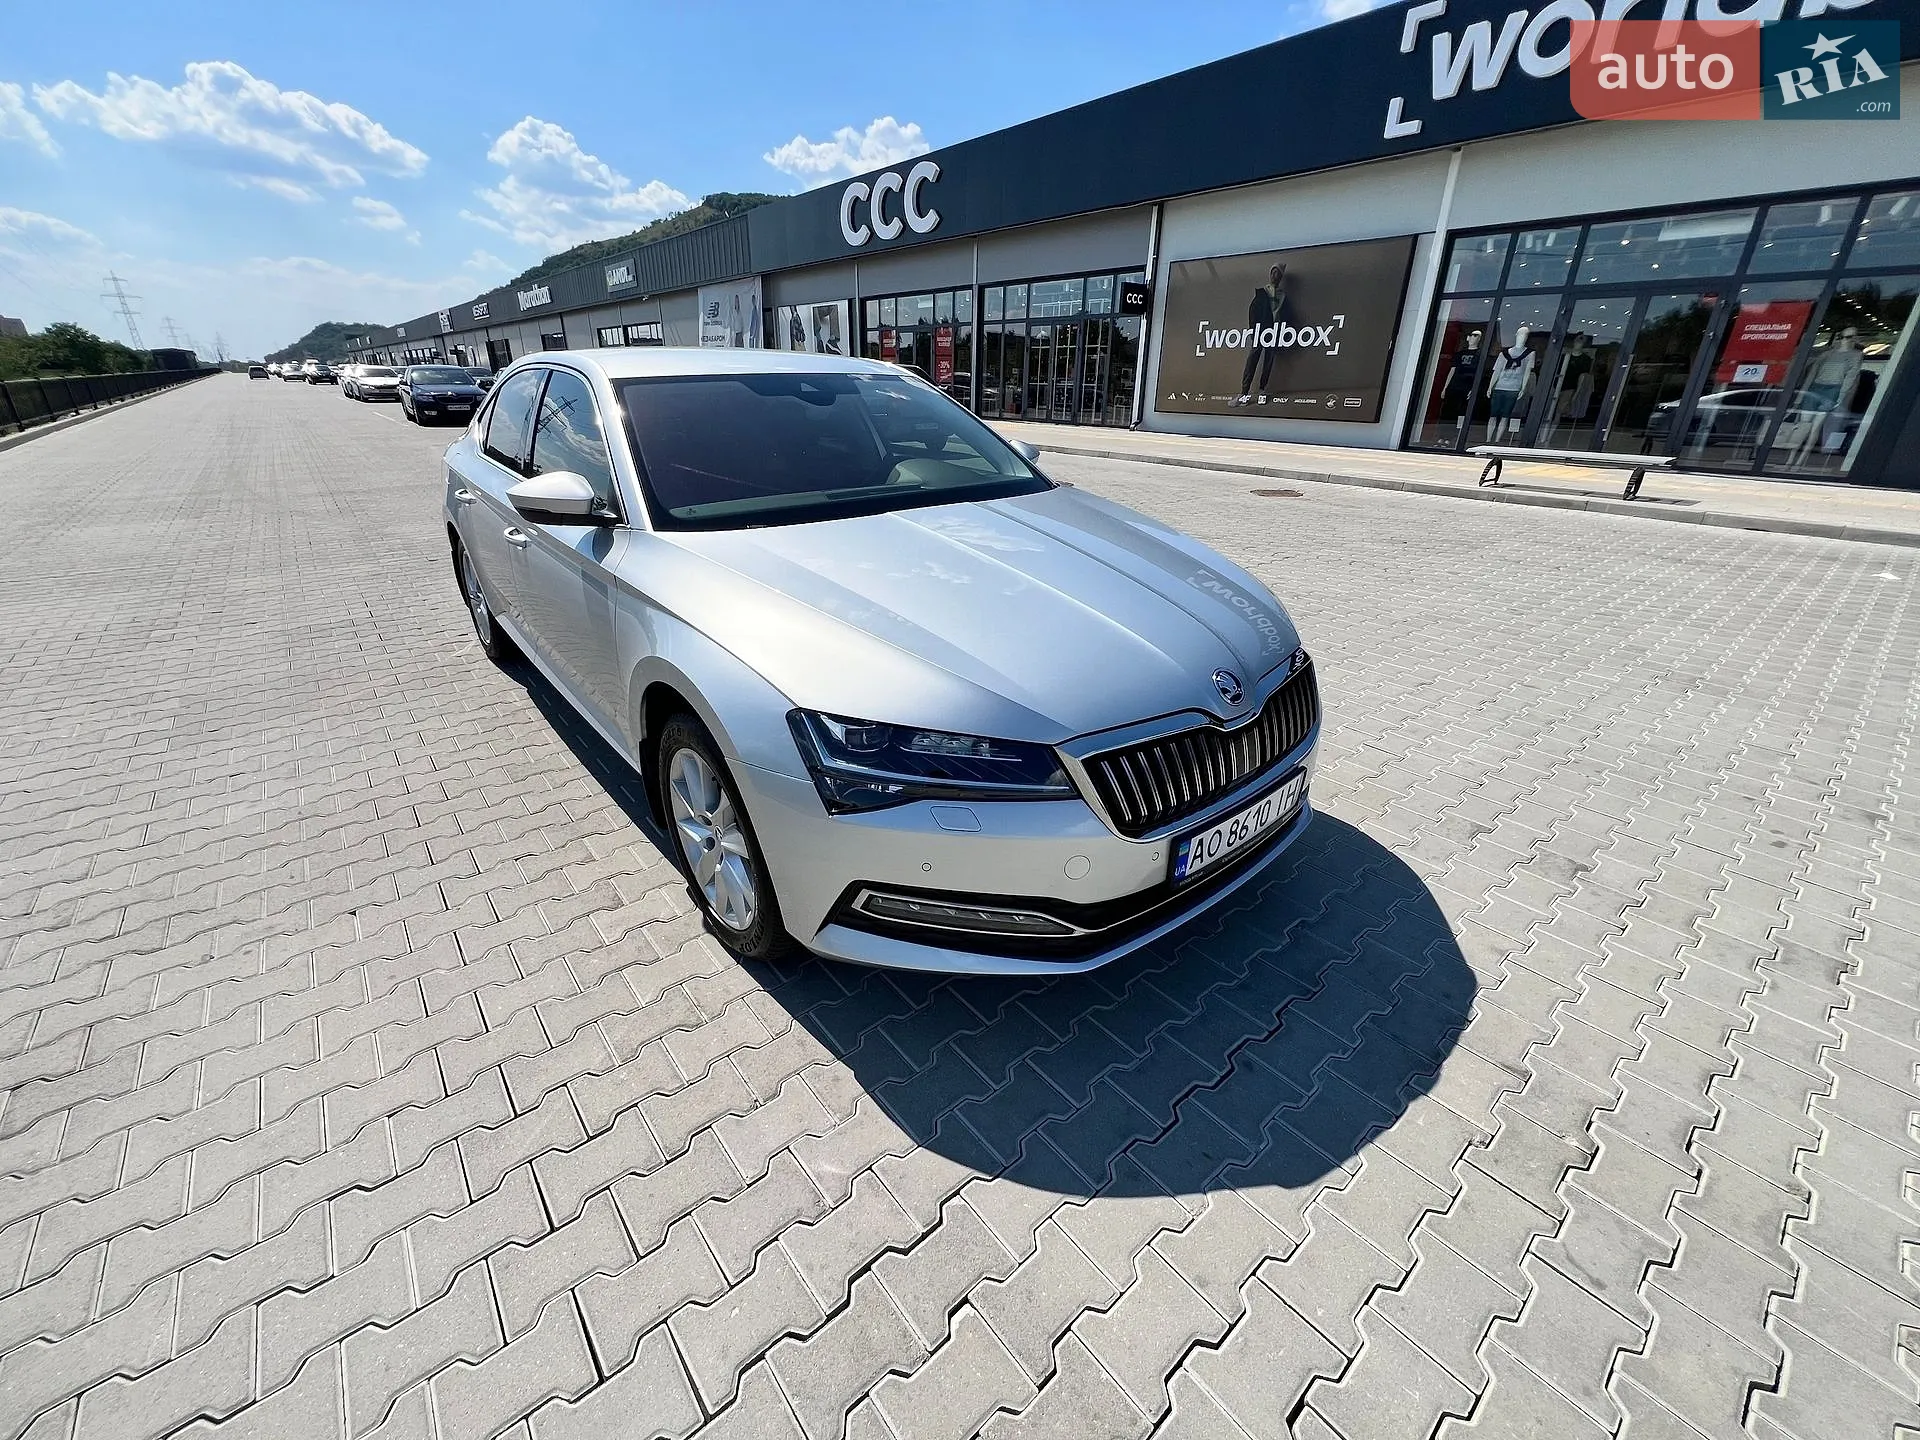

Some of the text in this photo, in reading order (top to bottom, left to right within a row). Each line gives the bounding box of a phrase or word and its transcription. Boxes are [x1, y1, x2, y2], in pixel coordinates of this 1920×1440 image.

[839, 160, 942, 247] CCC
[1126, 292, 1144, 305] CCC
[1204, 321, 1335, 349] worldbox
[1188, 829, 1222, 869] AO
[1226, 799, 1272, 848] 8610
[1276, 778, 1300, 817] IH
[1174, 864, 1186, 877] UA
